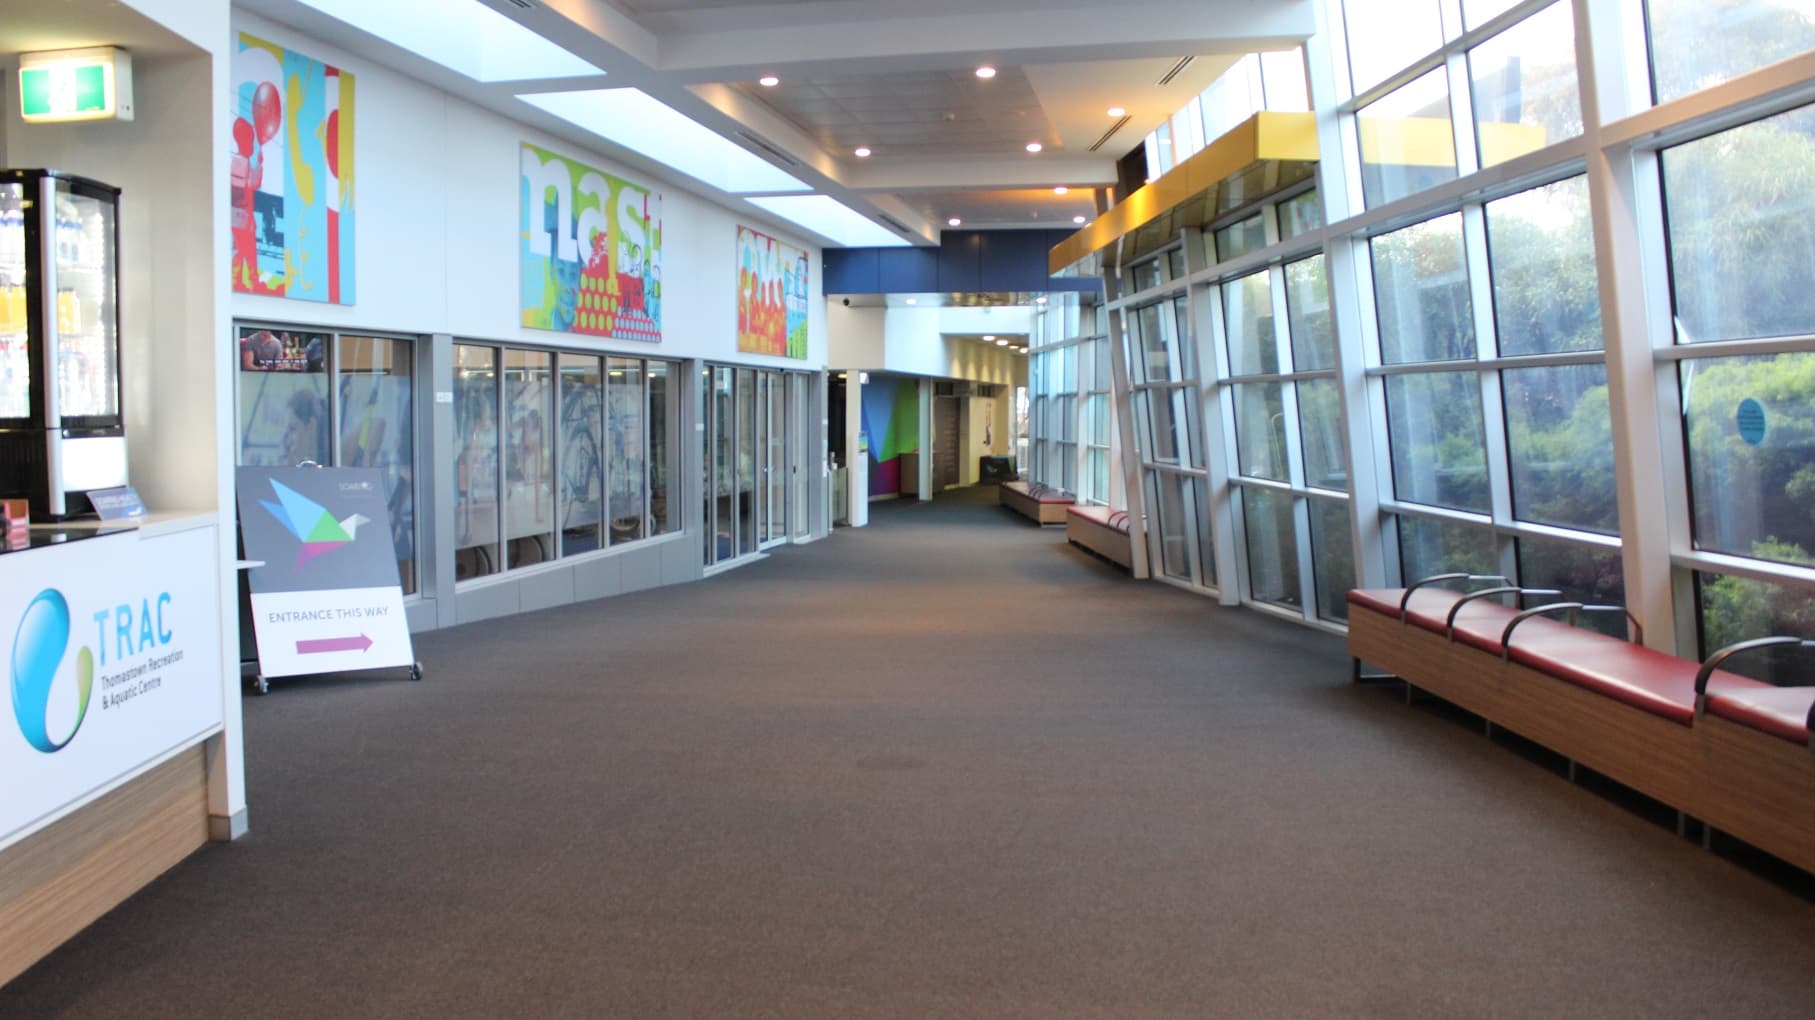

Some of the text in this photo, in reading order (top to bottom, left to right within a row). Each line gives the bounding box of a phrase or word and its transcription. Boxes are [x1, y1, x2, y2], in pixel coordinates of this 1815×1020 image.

[93, 591, 173, 667] TRAC
[268, 606, 389, 623] ENTRANCE THIS WAY
[101, 649, 184, 690] Thomastown Recreation
[102, 677, 161, 710] & Aquatic Centre
